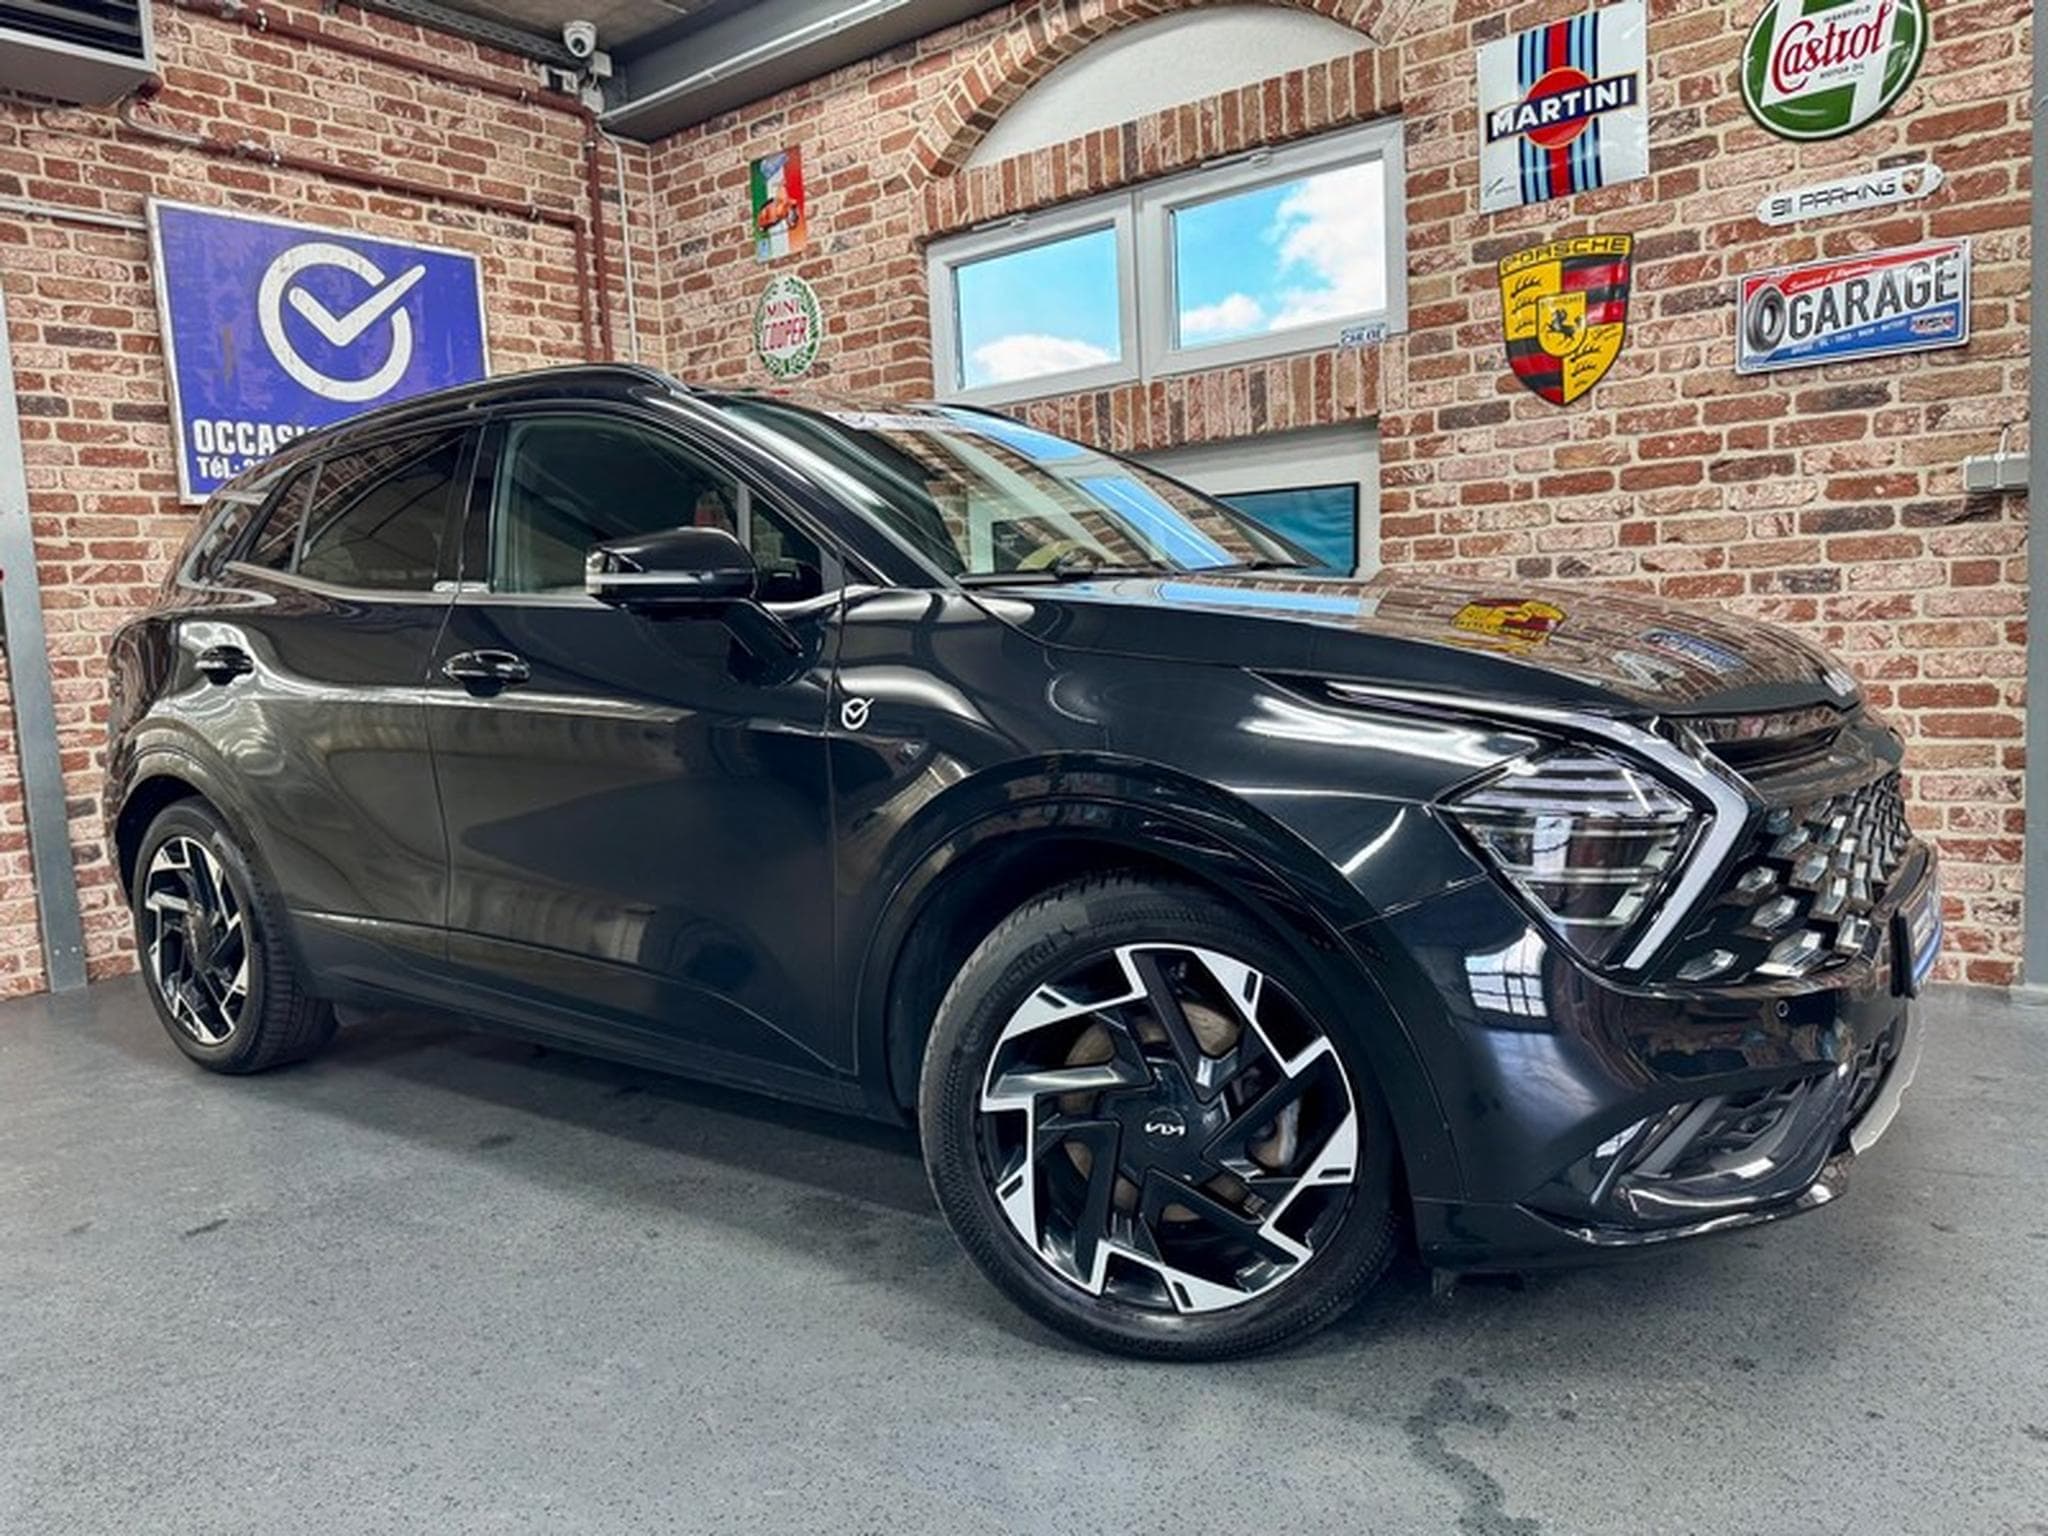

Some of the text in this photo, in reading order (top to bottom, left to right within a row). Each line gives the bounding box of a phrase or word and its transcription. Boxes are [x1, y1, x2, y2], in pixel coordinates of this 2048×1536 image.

[1771, 2, 1893, 95] Castrol
[1491, 78, 1630, 138] MARTINI
[1799, 176, 1897, 212] PARKING
[1502, 237, 1628, 273] PORSCHE
[763, 316, 808, 351] COOPER
[193, 419, 317, 456] OCCAS
